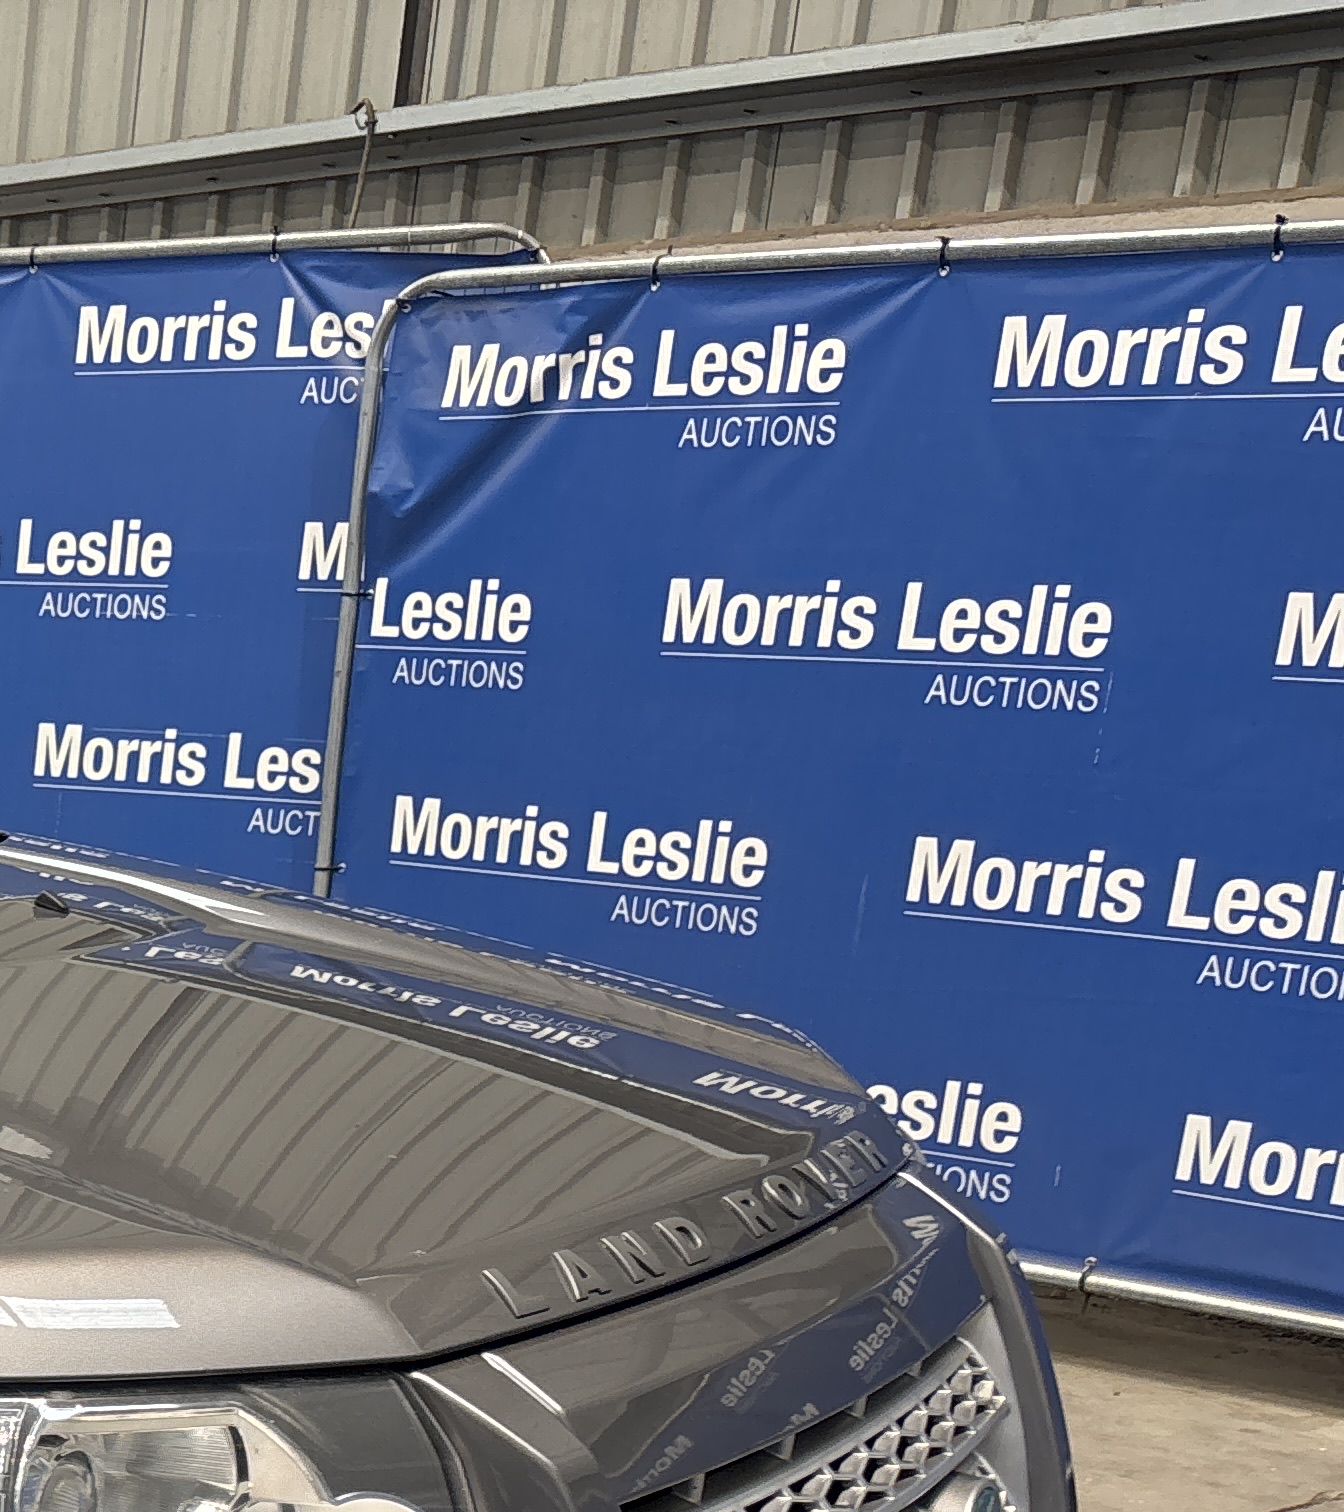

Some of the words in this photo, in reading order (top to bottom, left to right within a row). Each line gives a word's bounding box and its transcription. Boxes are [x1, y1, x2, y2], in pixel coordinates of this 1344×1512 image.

[76, 299, 258, 364] Morris
[275, 297, 374, 359] Les
[993, 308, 1248, 388] Morris
[440, 333, 633, 408] Morris
[652, 323, 846, 397] Leslie
[678, 415, 837, 448] AUCTIONS
[15, 518, 173, 578] Leslie
[38, 593, 167, 621] AUCTIONS
[370, 577, 532, 643] Leslie
[661, 578, 878, 651] Morris
[897, 582, 1112, 659] Leslie
[392, 658, 525, 690] AUCTIONS
[924, 673, 1100, 712] AUCTIONS
[34, 722, 207, 786] Morris
[223, 732, 322, 794] Les
[390, 795, 570, 871] Morris
[586, 811, 768, 888] Leslie
[905, 836, 1145, 925] Morris
[611, 894, 759, 936] AUCTIONS
[1196, 954, 1344, 1001] AUCTIO
[480, 1216, 711, 1319] LAND
[722, 1130, 890, 1238] ROVER
